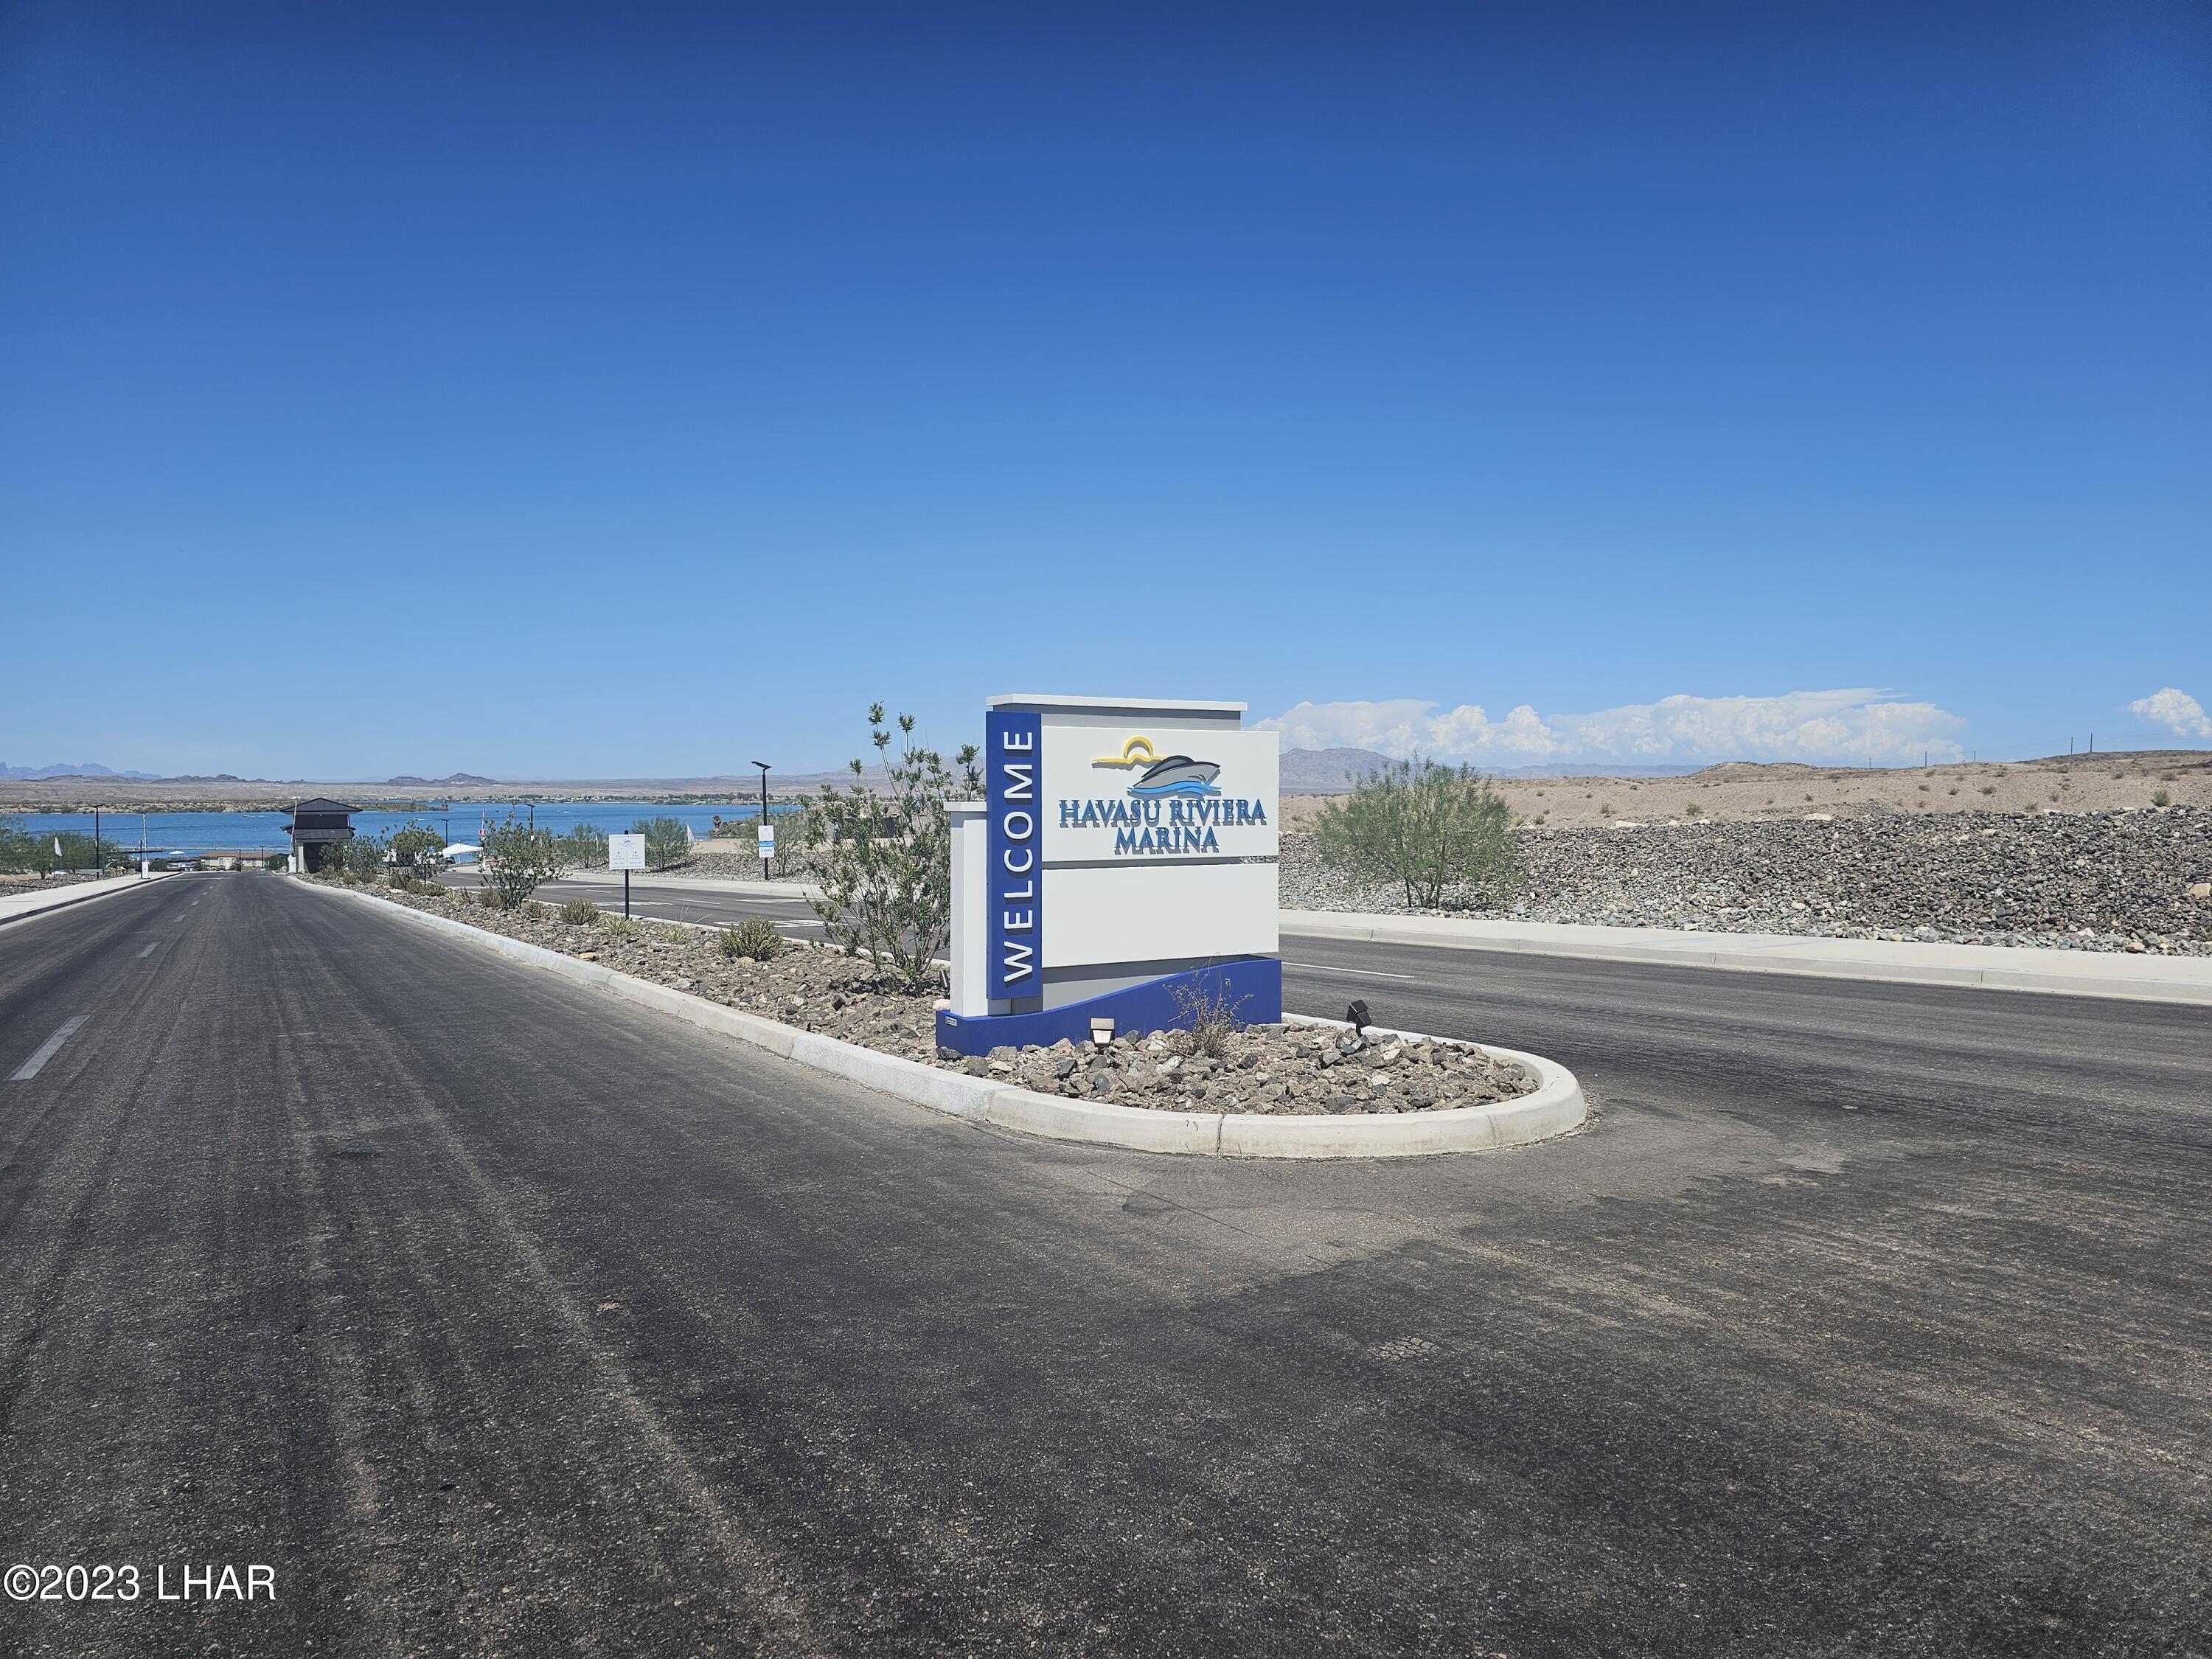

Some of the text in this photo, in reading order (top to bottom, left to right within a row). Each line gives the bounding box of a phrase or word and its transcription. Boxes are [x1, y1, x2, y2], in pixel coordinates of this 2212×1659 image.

[1059, 799, 1267, 825] HAVASU RIVIERA
[1114, 826, 1220, 852] MARINA
[1004, 731, 1033, 982] WELCOME
